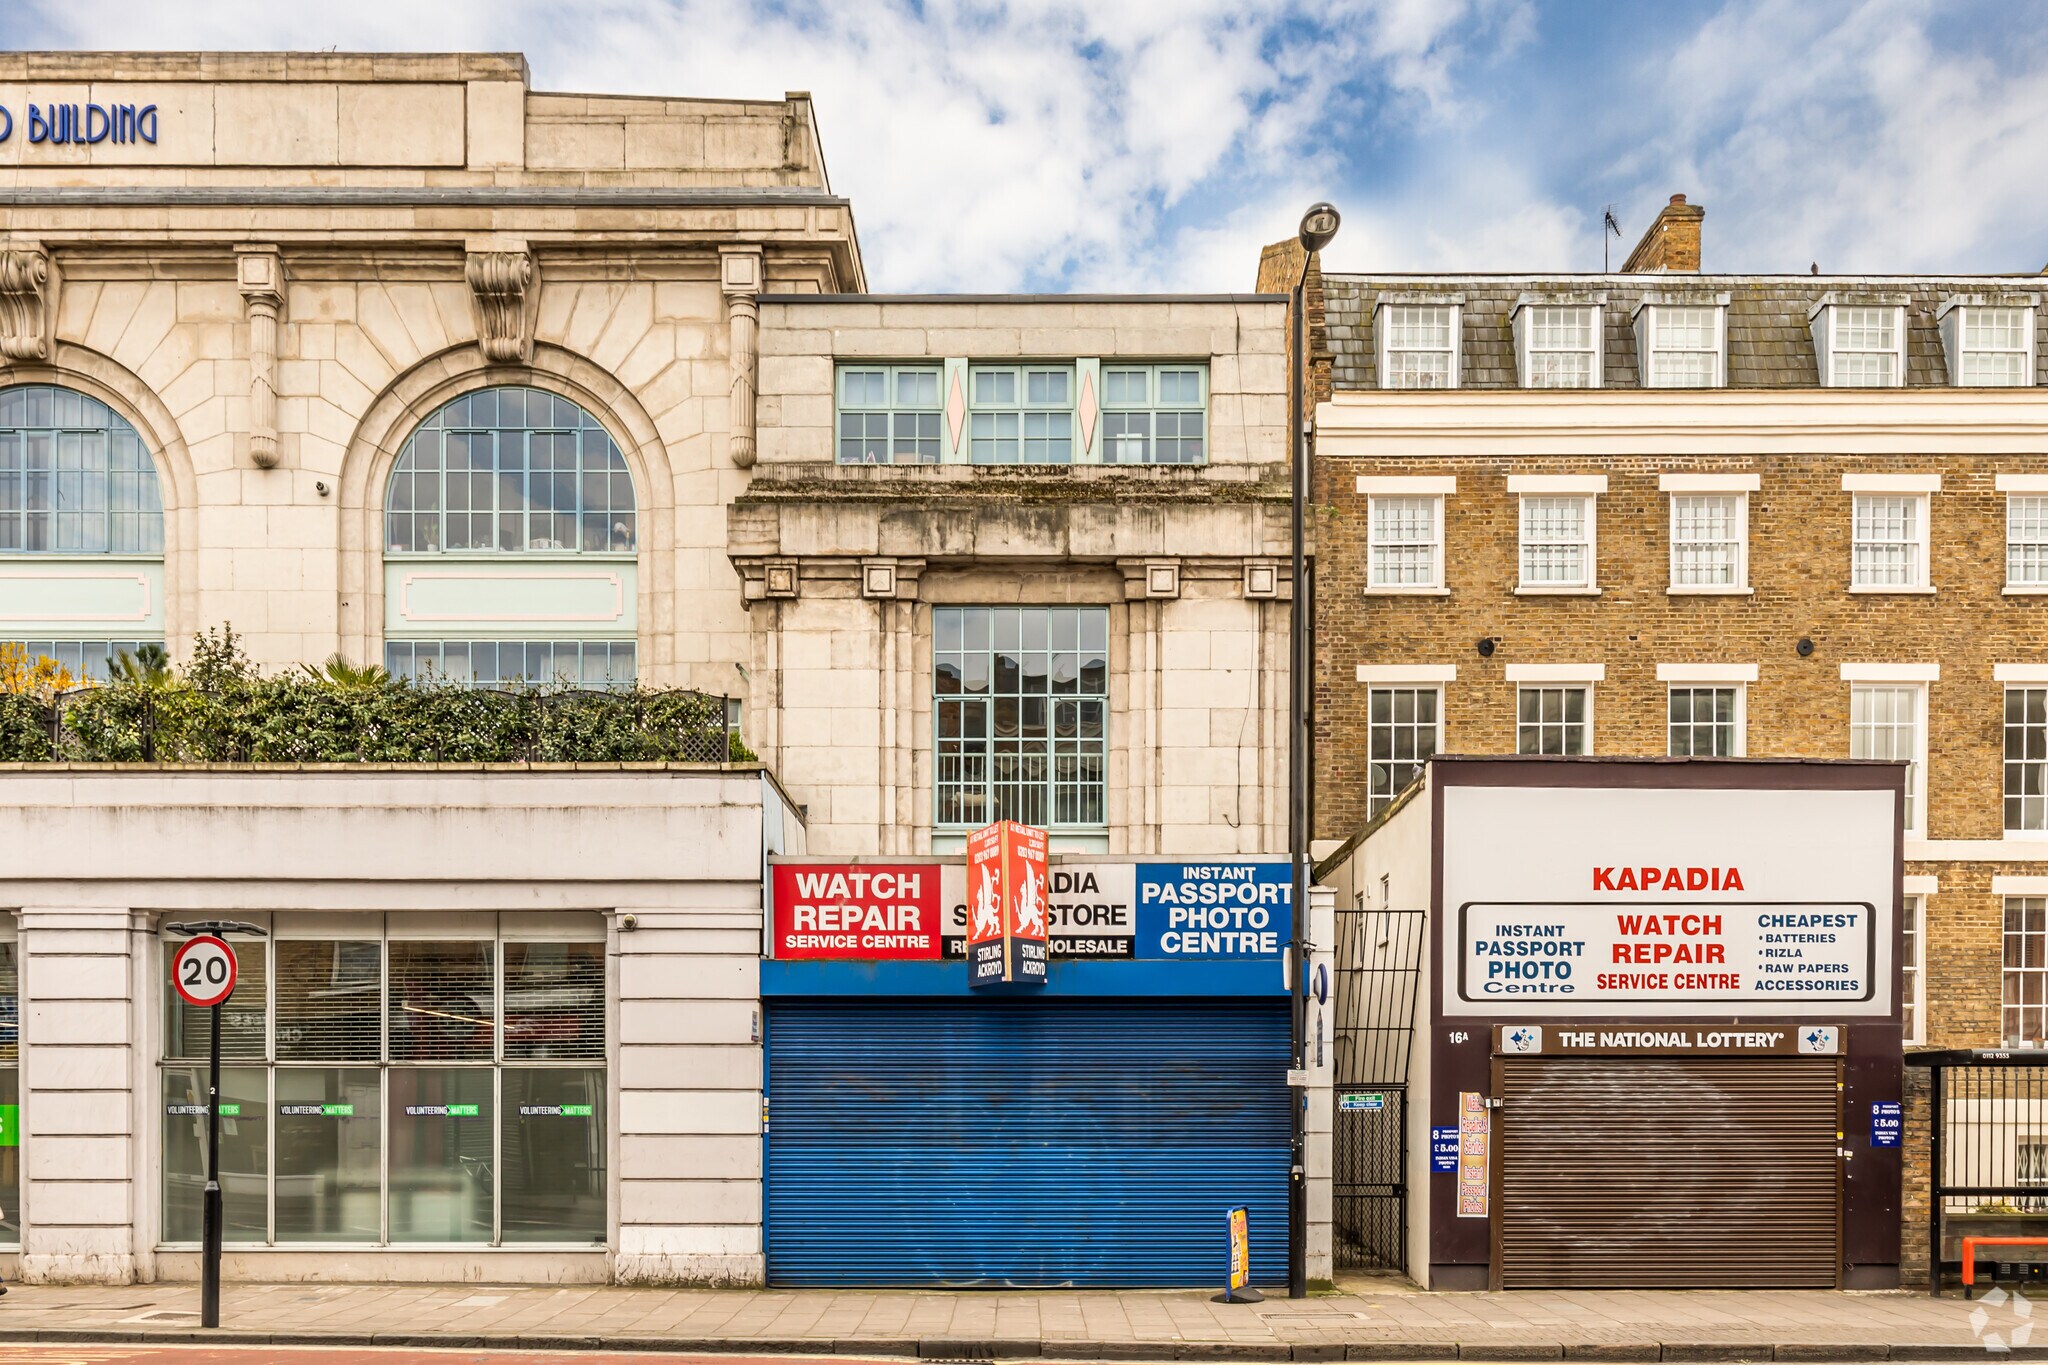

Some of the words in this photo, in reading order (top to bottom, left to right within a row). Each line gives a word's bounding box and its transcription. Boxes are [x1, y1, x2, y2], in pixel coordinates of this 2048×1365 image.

[28, 103, 157, 145] BUILDING
[1183, 867, 1256, 880] INSTANT
[1593, 867, 1744, 891] KAPADIA
[795, 873, 920, 899] WATCH
[1142, 882, 1292, 904] PASSPORT
[793, 905, 920, 931] REPAIR
[1169, 907, 1270, 929] PHOTO
[1617, 915, 1722, 935] WATCH
[1758, 914, 1858, 928] CHEAPEST
[1495, 925, 1565, 937] INSTANT
[1765, 934, 1836, 943] BATTERIES
[785, 935, 857, 948] SERVICE
[862, 935, 929, 948] CENTRE
[1160, 932, 1278, 953] CENTRE
[1475, 941, 1585, 956] PASSPORT
[977, 944, 1002, 962] STIRLING
[1022, 944, 1045, 960] STIRLING
[1612, 944, 1725, 963] REPAIR
[1765, 949, 1803, 958] RIZLA
[183, 956, 227, 985] 20
[977, 962, 1003, 978] ACKROYD
[1022, 961, 1046, 976] ACKROYD
[1488, 961, 1572, 979] PHOTO
[1765, 964, 1794, 973] RAW
[1798, 964, 1849, 973] PAPERS
[1483, 982, 1575, 993] Centre
[1597, 973, 1668, 990] SERVICE
[1674, 973, 1740, 990] CENTRE
[1754, 980, 1859, 991] ACCESSORIES
[1449, 1031, 1469, 1044] 16A
[1558, 1032, 1596, 1048] THE
[1600, 1032, 1692, 1048] NATIONAL
[167, 1106, 208, 1115] VOLUNTEERING
[219, 1106, 239, 1114] ATTERS
[281, 1106, 322, 1115] VOLUNTEERING
[326, 1106, 353, 1114] MATTERS
[406, 1106, 447, 1115] VOLUNTEERING
[451, 1106, 478, 1114] MATTERS
[519, 1106, 561, 1115] VOLUNTEERING
[565, 1106, 592, 1114] MATTERS
[1873, 1104, 1879, 1115] 8
[1432, 1130, 1439, 1140] 8
